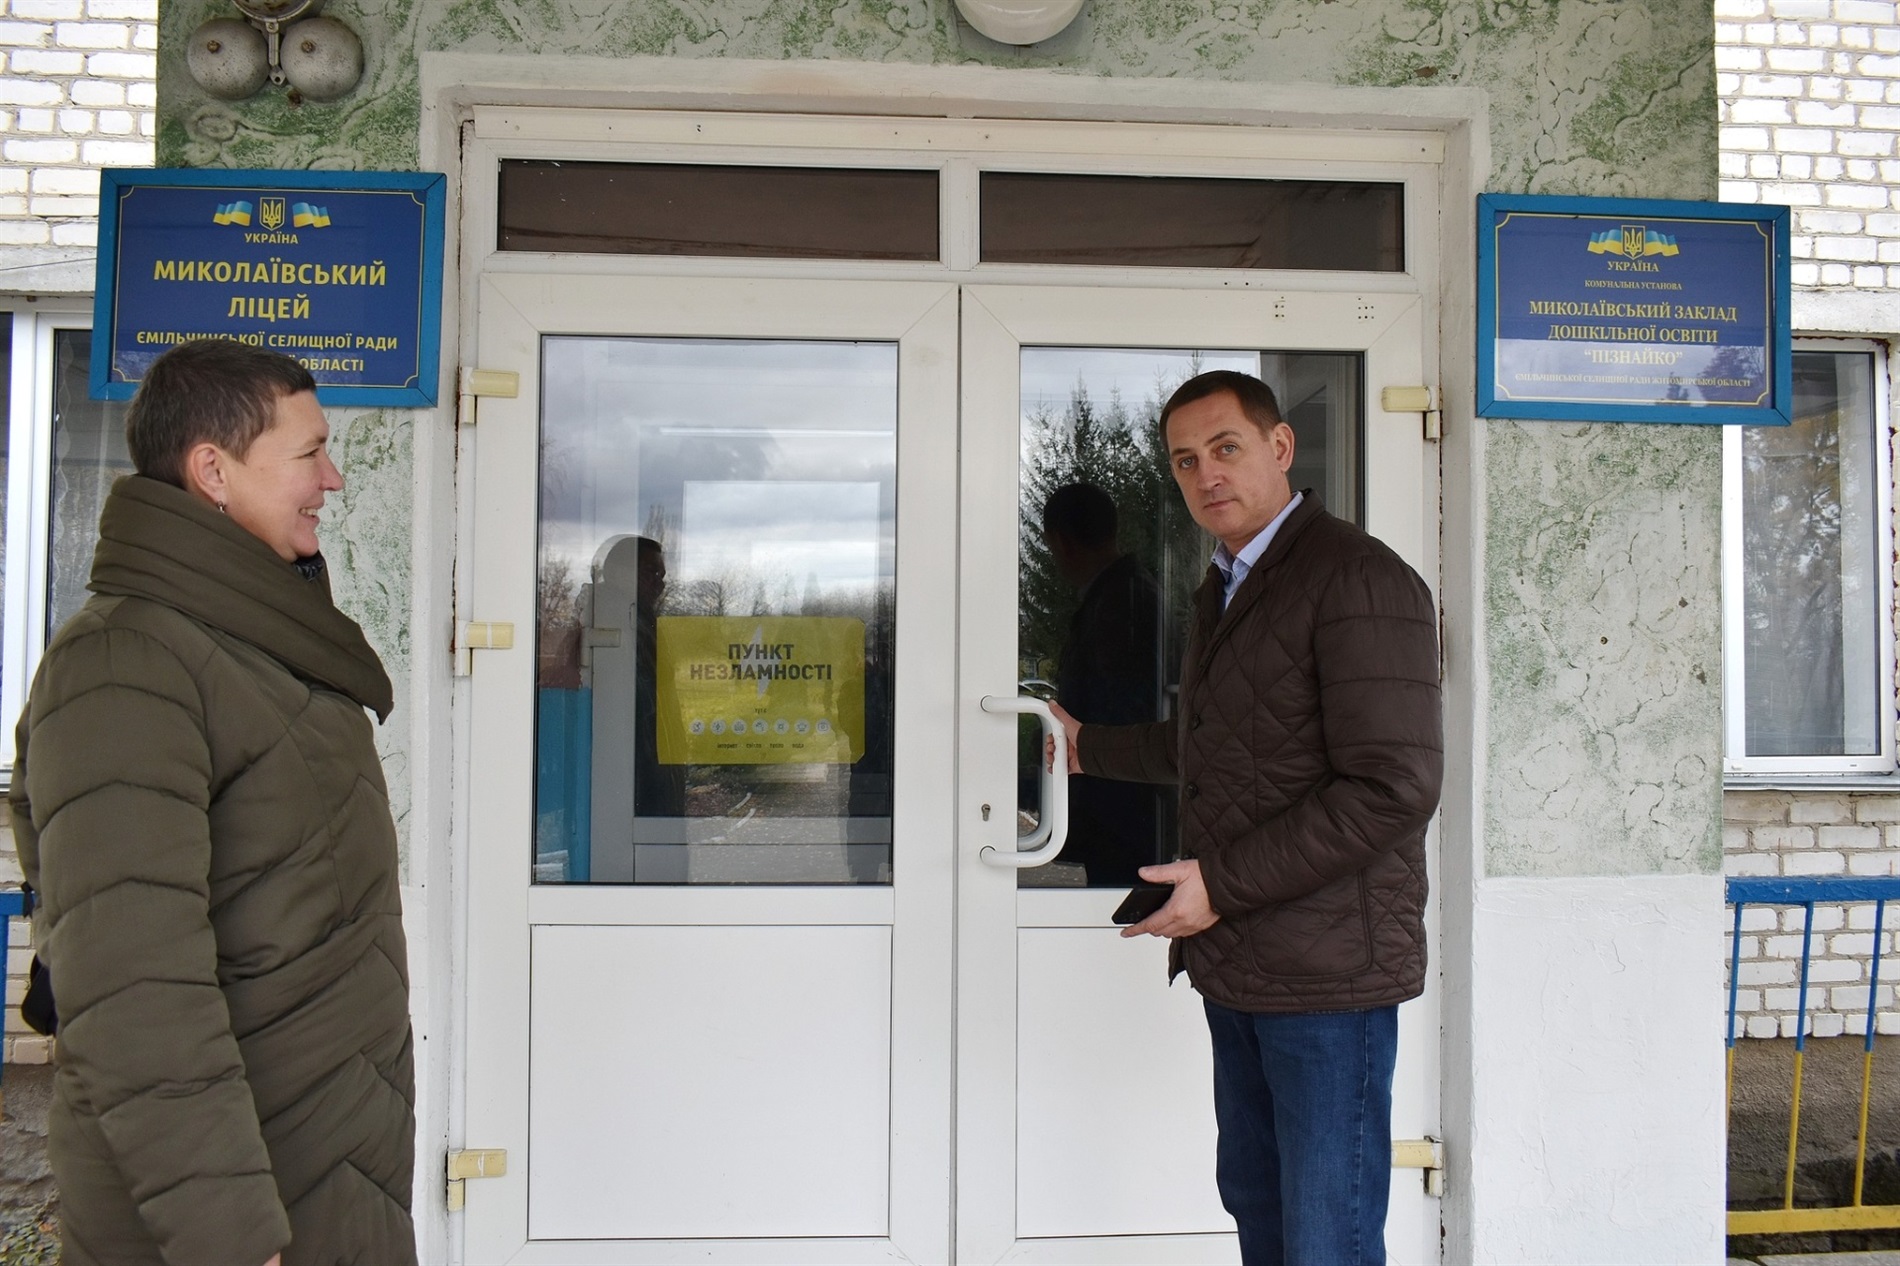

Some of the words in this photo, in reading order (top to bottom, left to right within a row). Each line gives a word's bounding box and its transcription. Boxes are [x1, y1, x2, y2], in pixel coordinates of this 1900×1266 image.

[244, 232, 299, 245] УКРАЇНА
[153, 257, 387, 286] МИКОЛАЇВСЬКИЙ
[1607, 260, 1660, 273] УКРАЇНА
[1584, 279, 1640, 290] КОМУНАЛЬНА
[1641, 281, 1683, 291] УСТАНОВА
[227, 293, 310, 322] ЛІЦЕЙ
[1529, 300, 1671, 320] МИКОЛАЇВСЬКИЙ
[1674, 305, 1738, 322] ЗАКЛАД
[268, 333, 353, 350] СЕЛИЩНОЇ
[355, 336, 398, 352] РАДИ
[1547, 325, 1657, 342] ДОШКІЛЬНОЇ
[1659, 328, 1719, 343] ОСВІТИ
[298, 357, 364, 372] ОБЛАСТІ
[728, 643, 795, 660] ПУНКТ
[690, 663, 832, 681] НЕЗЛАМНОСТІ
